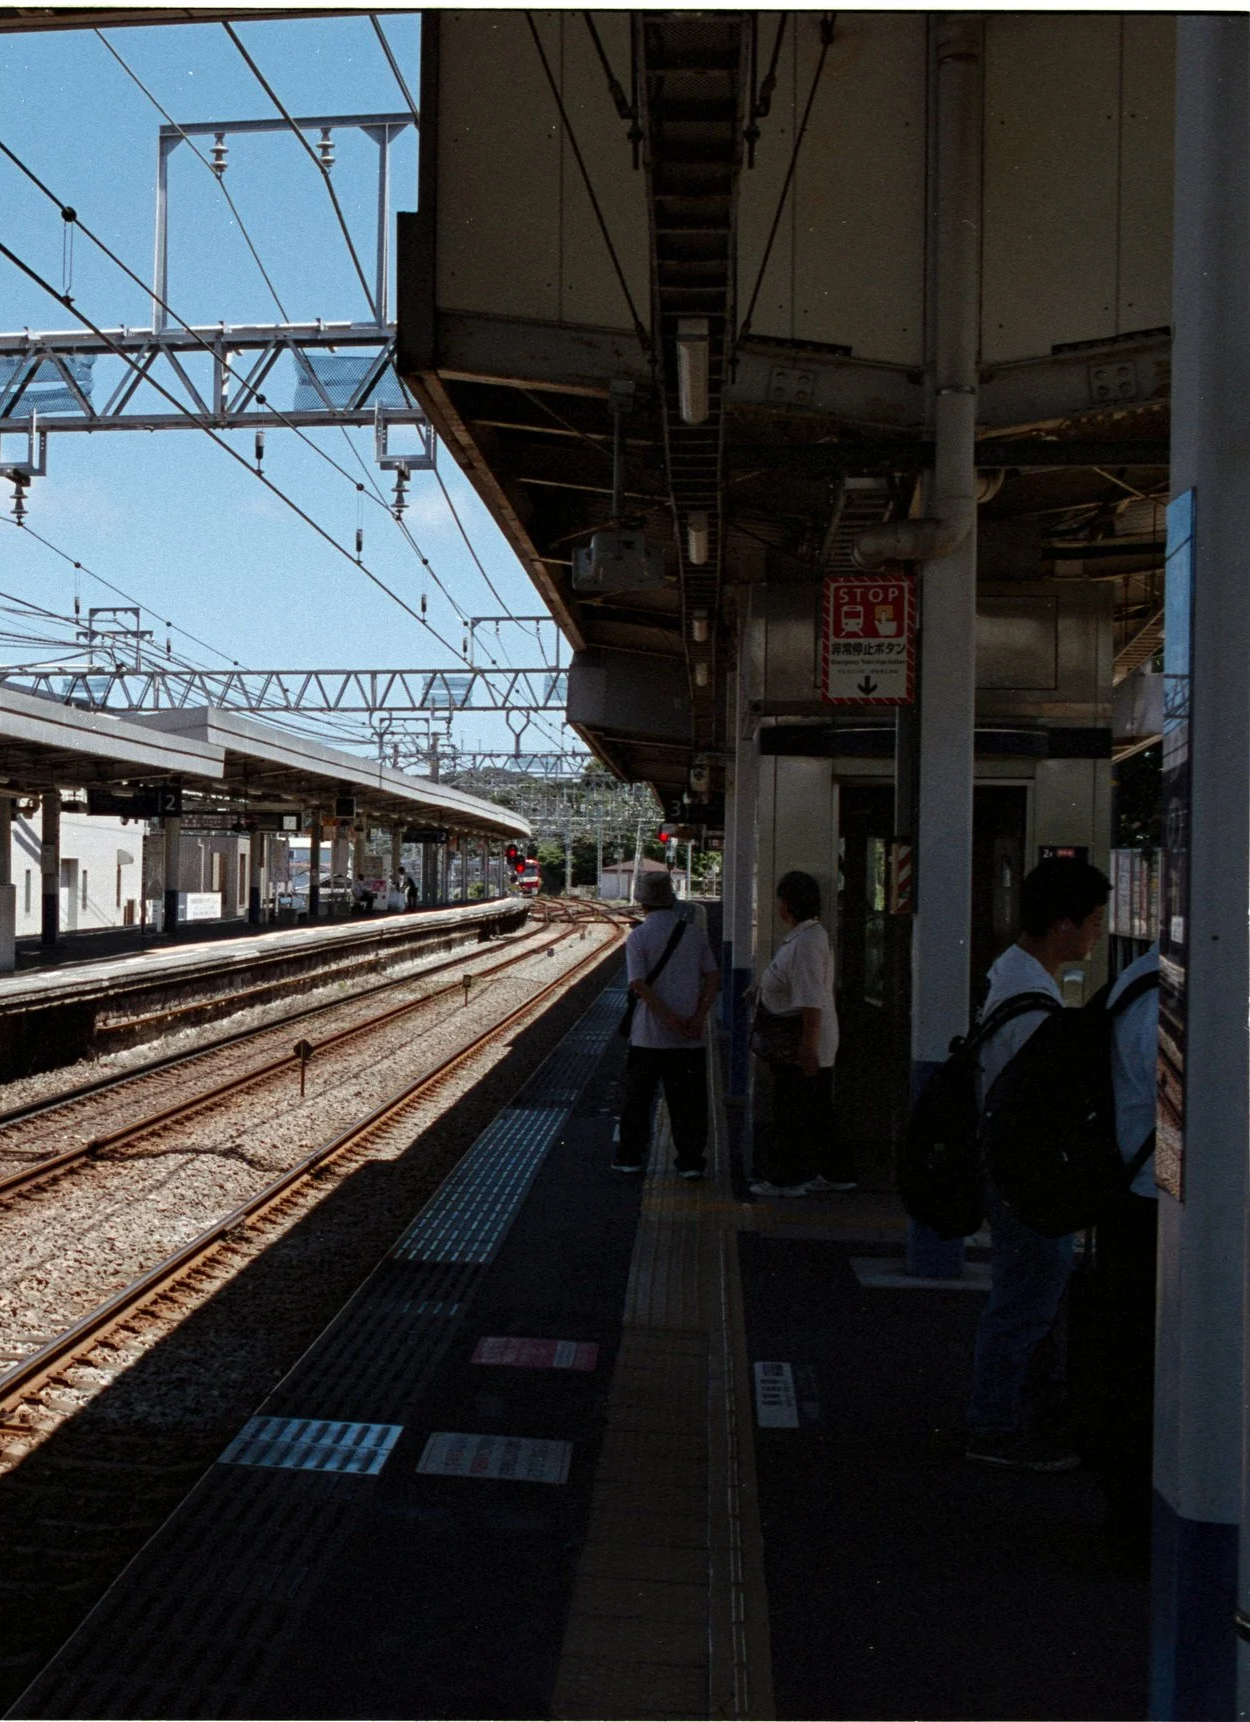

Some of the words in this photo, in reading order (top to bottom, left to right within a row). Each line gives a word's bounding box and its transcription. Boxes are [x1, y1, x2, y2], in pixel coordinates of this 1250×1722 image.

[839, 588, 899, 603] STOP
[831, 642, 906, 656] 非常停止ボタン
[164, 794, 178, 812] 2
[670, 800, 682, 817] 3
[440, 832, 447, 841] 2
